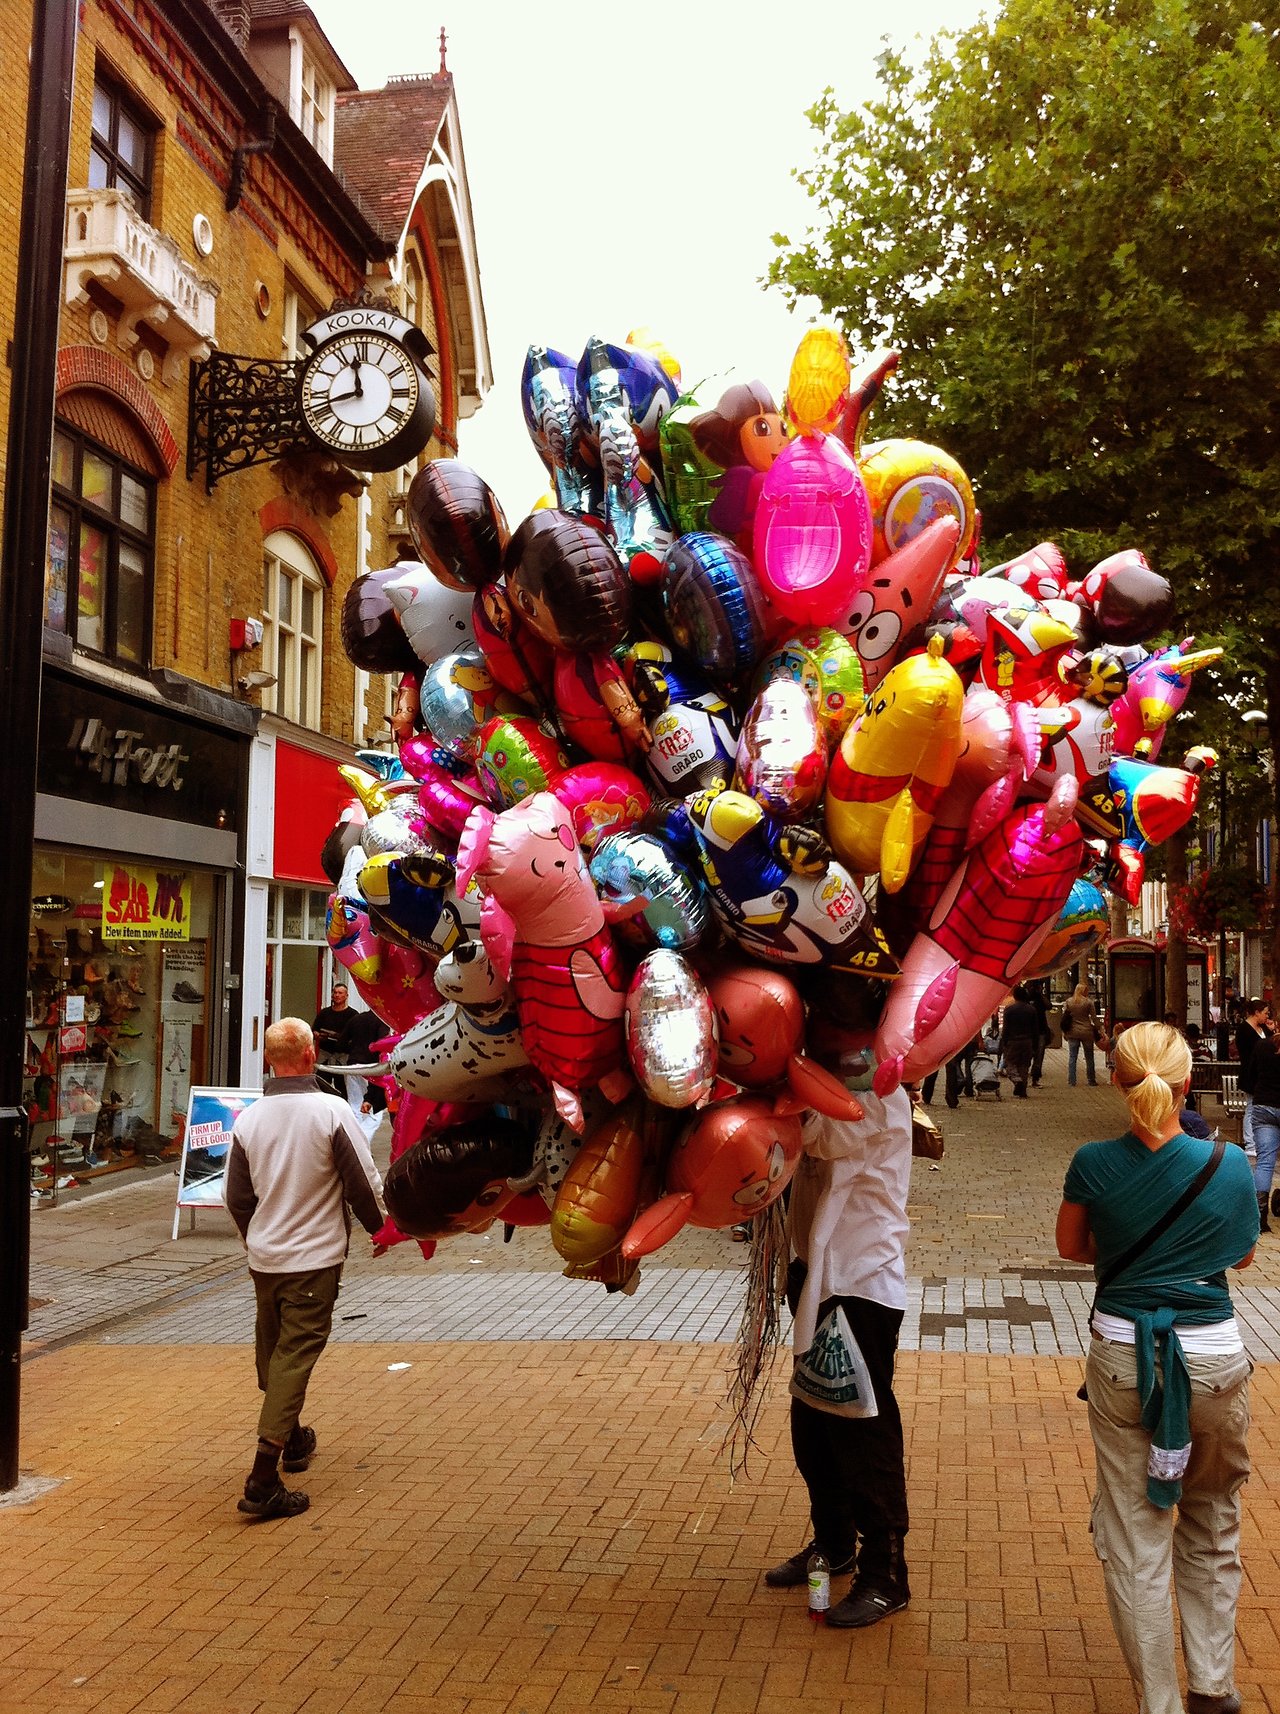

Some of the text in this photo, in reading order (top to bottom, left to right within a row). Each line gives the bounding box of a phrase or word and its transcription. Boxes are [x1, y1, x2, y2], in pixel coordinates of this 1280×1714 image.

[671, 748, 704, 775] GRABO
[1092, 793, 1114, 813] 45
[839, 904, 864, 935] GRABO
[106, 926, 122, 937] New
[123, 927, 142, 938] item
[143, 930, 159, 938] now
[411, 936, 438, 951] GRABO
[850, 951, 880, 968] 45
[190, 1124, 209, 1136] FIRM
[191, 1133, 230, 1148] FEEL GOOD
